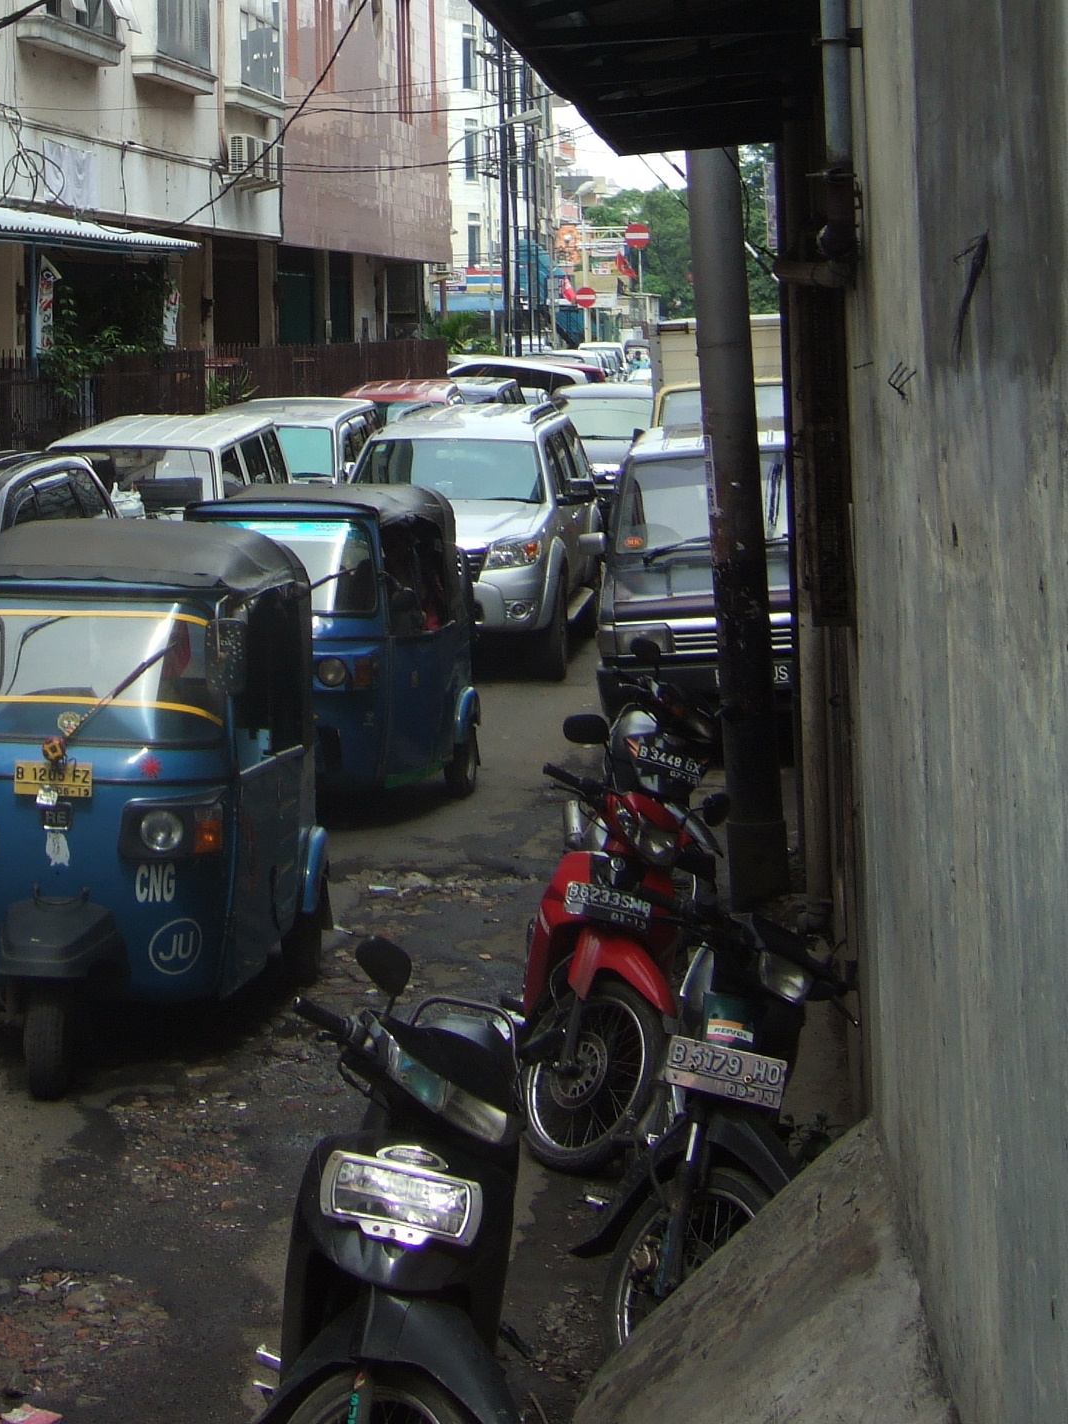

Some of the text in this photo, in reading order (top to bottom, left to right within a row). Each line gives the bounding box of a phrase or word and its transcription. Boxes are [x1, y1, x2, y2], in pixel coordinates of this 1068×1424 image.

[72, 769, 90, 784] FZ
[45, 811, 67, 824] RE
[135, 863, 176, 903] CNG
[158, 931, 194, 961] JU
[673, 1043, 687, 1064] B
